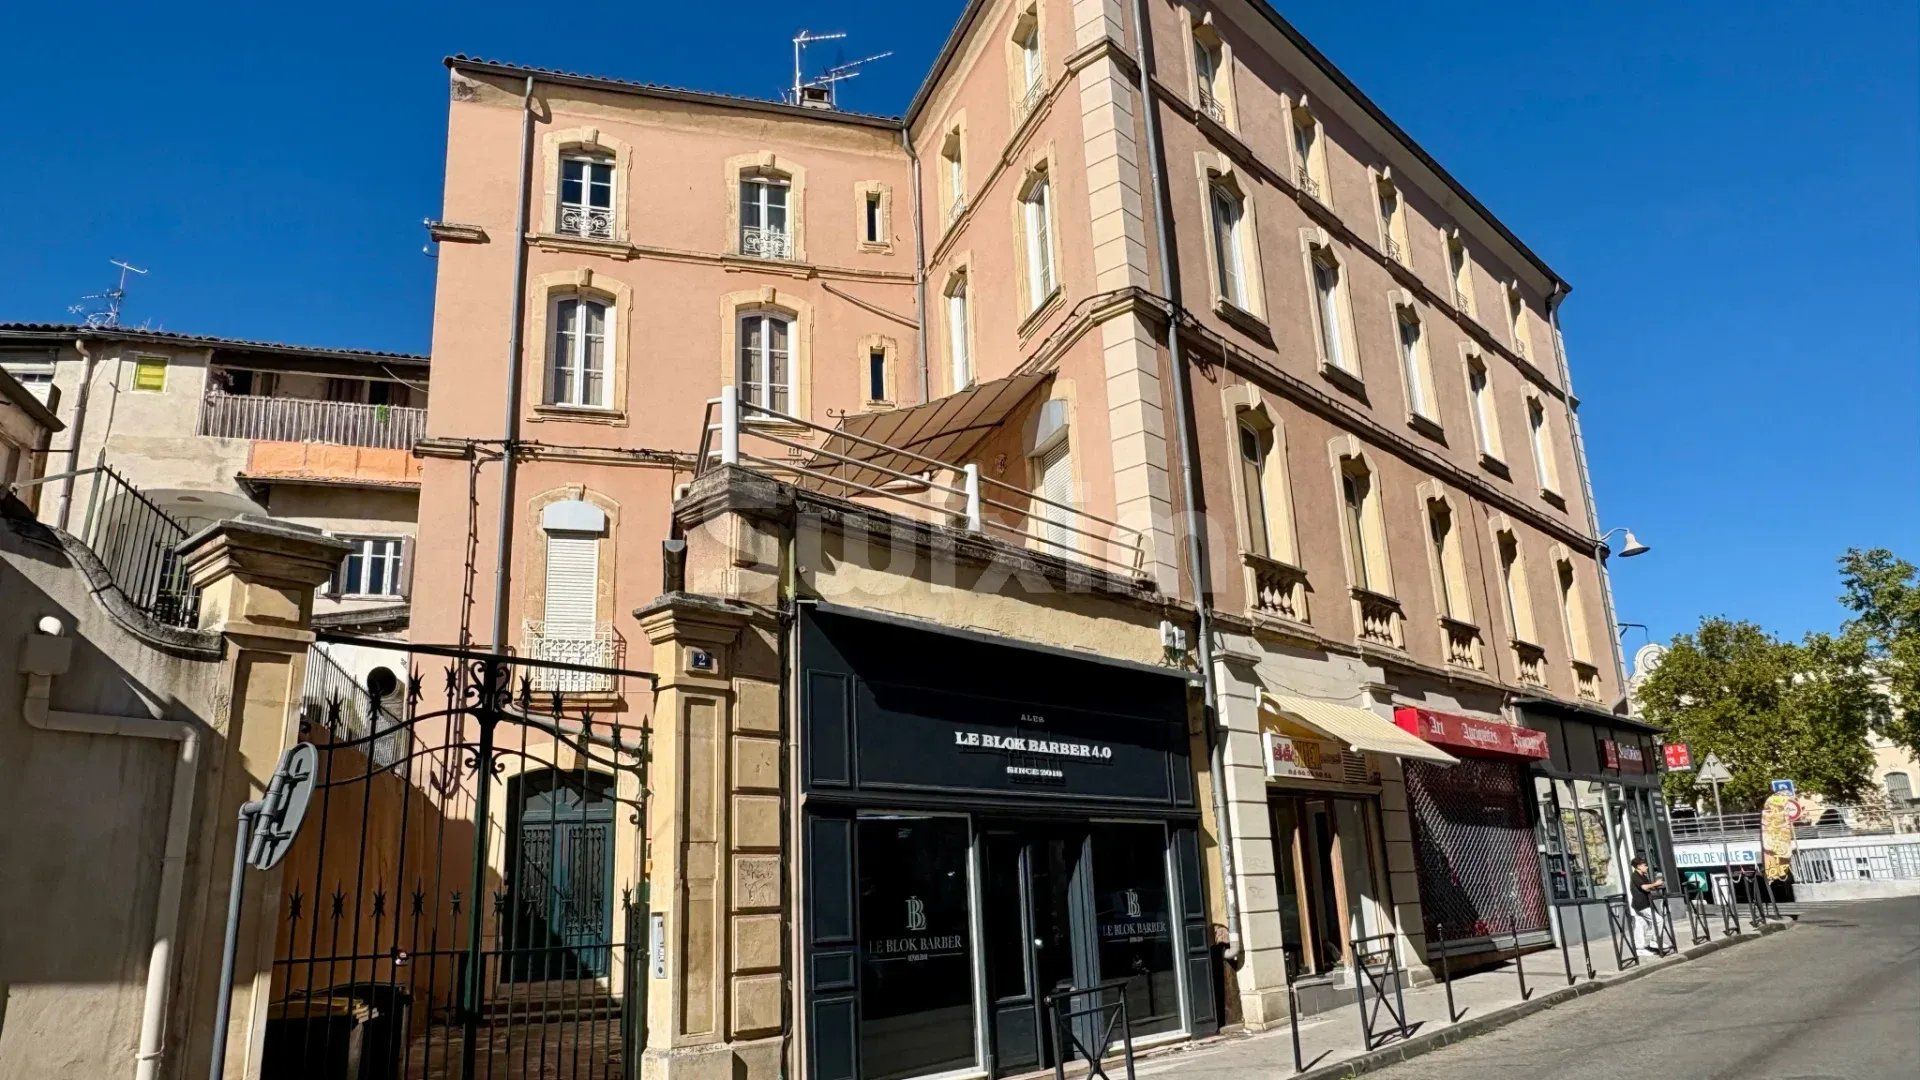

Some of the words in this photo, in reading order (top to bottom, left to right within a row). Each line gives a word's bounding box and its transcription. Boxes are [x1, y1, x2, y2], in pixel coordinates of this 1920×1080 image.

[698, 653, 706, 666] 2
[955, 731, 980, 746] LE
[982, 735, 1026, 750] BLOK
[1028, 740, 1092, 757] BARBER
[1092, 745, 1112, 759] 4.0
[1006, 766, 1040, 776] SINCE
[1676, 850, 1703, 865] HÔTEL
[1704, 852, 1716, 863] DE
[1103, 924, 1113, 936] LE
[1114, 922, 1135, 935] BLOK
[1137, 921, 1167, 934] BARBER
[869, 940, 883, 954] LE
[886, 938, 918, 953] BLOK
[921, 935, 962, 951] BARBER
